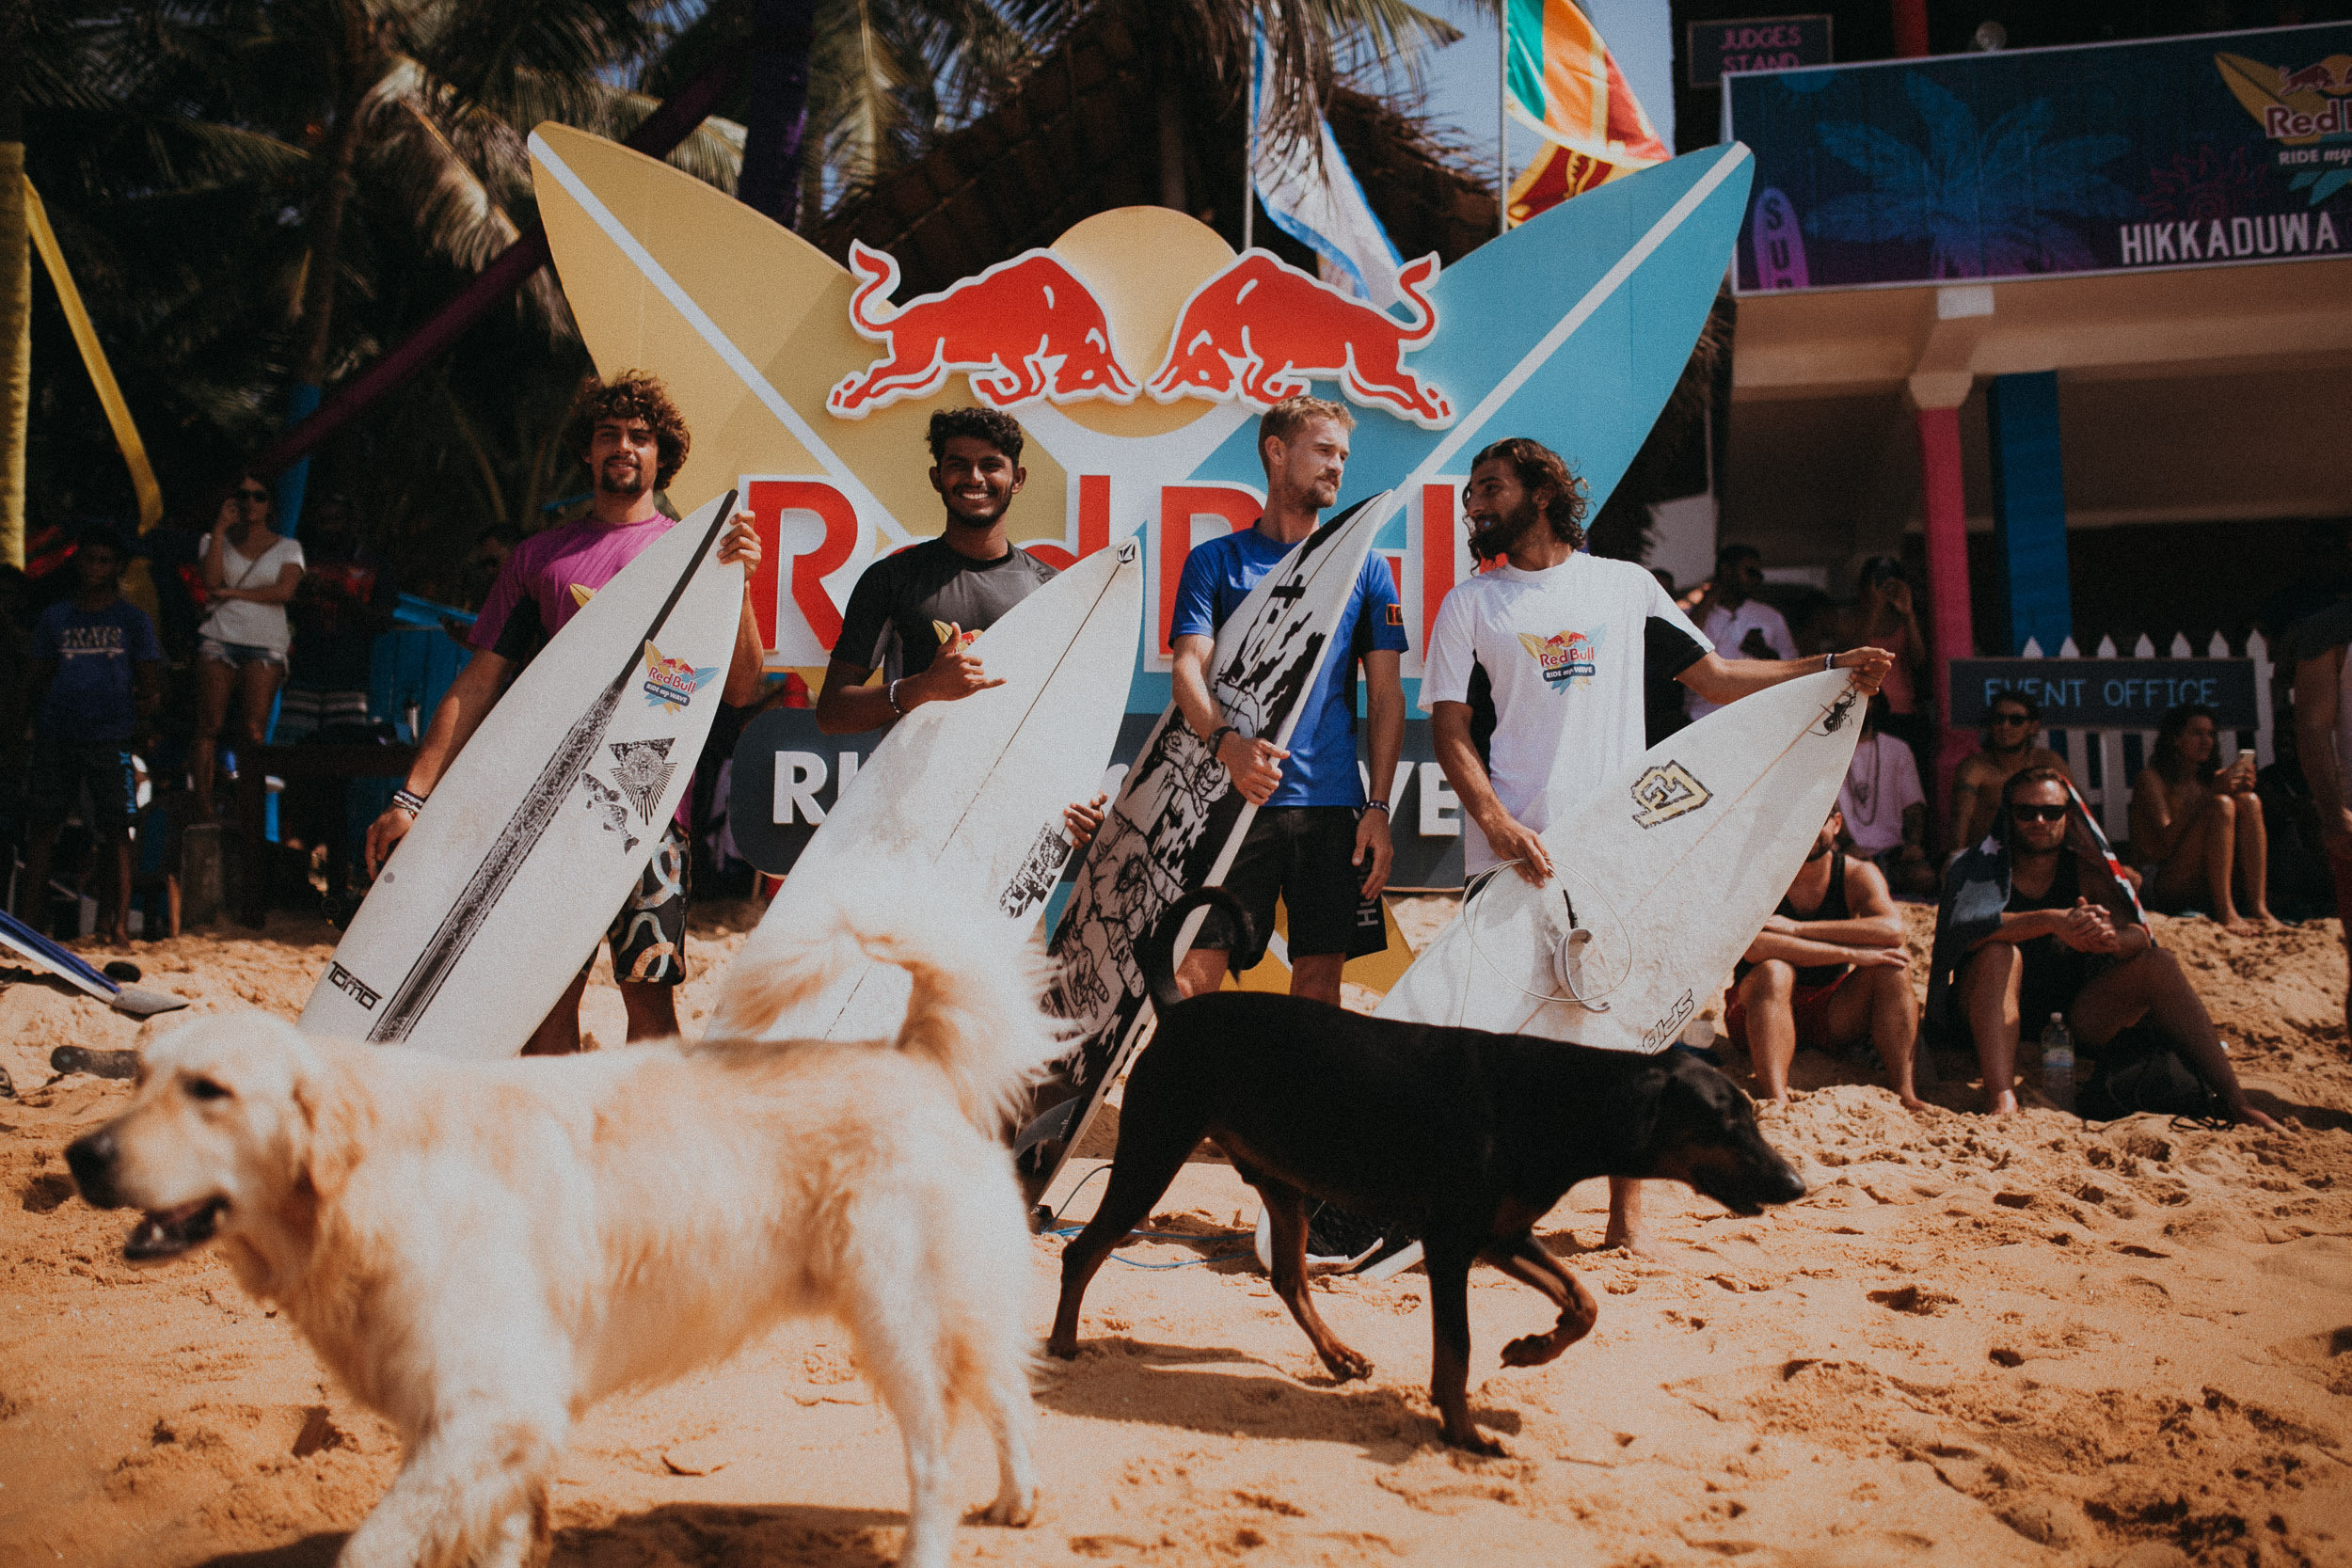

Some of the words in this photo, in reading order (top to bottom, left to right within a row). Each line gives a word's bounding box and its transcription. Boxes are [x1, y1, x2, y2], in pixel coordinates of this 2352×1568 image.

[1720, 24, 1802, 51] JUDGES
[1723, 52, 1800, 72] STAND
[2265, 98, 2341, 138] Red
[2279, 150, 2319, 165] RIDE
[1764, 197, 1792, 289] SU
[2121, 211, 2339, 264] HIKKADUWA
[1539, 649, 1568, 667] Red
[1569, 647, 1595, 661] Bull
[648, 666, 673, 685] Red
[672, 675, 697, 694] Bull
[1546, 670, 1562, 679] RIDE
[2103, 678, 2220, 707] OFFICE
